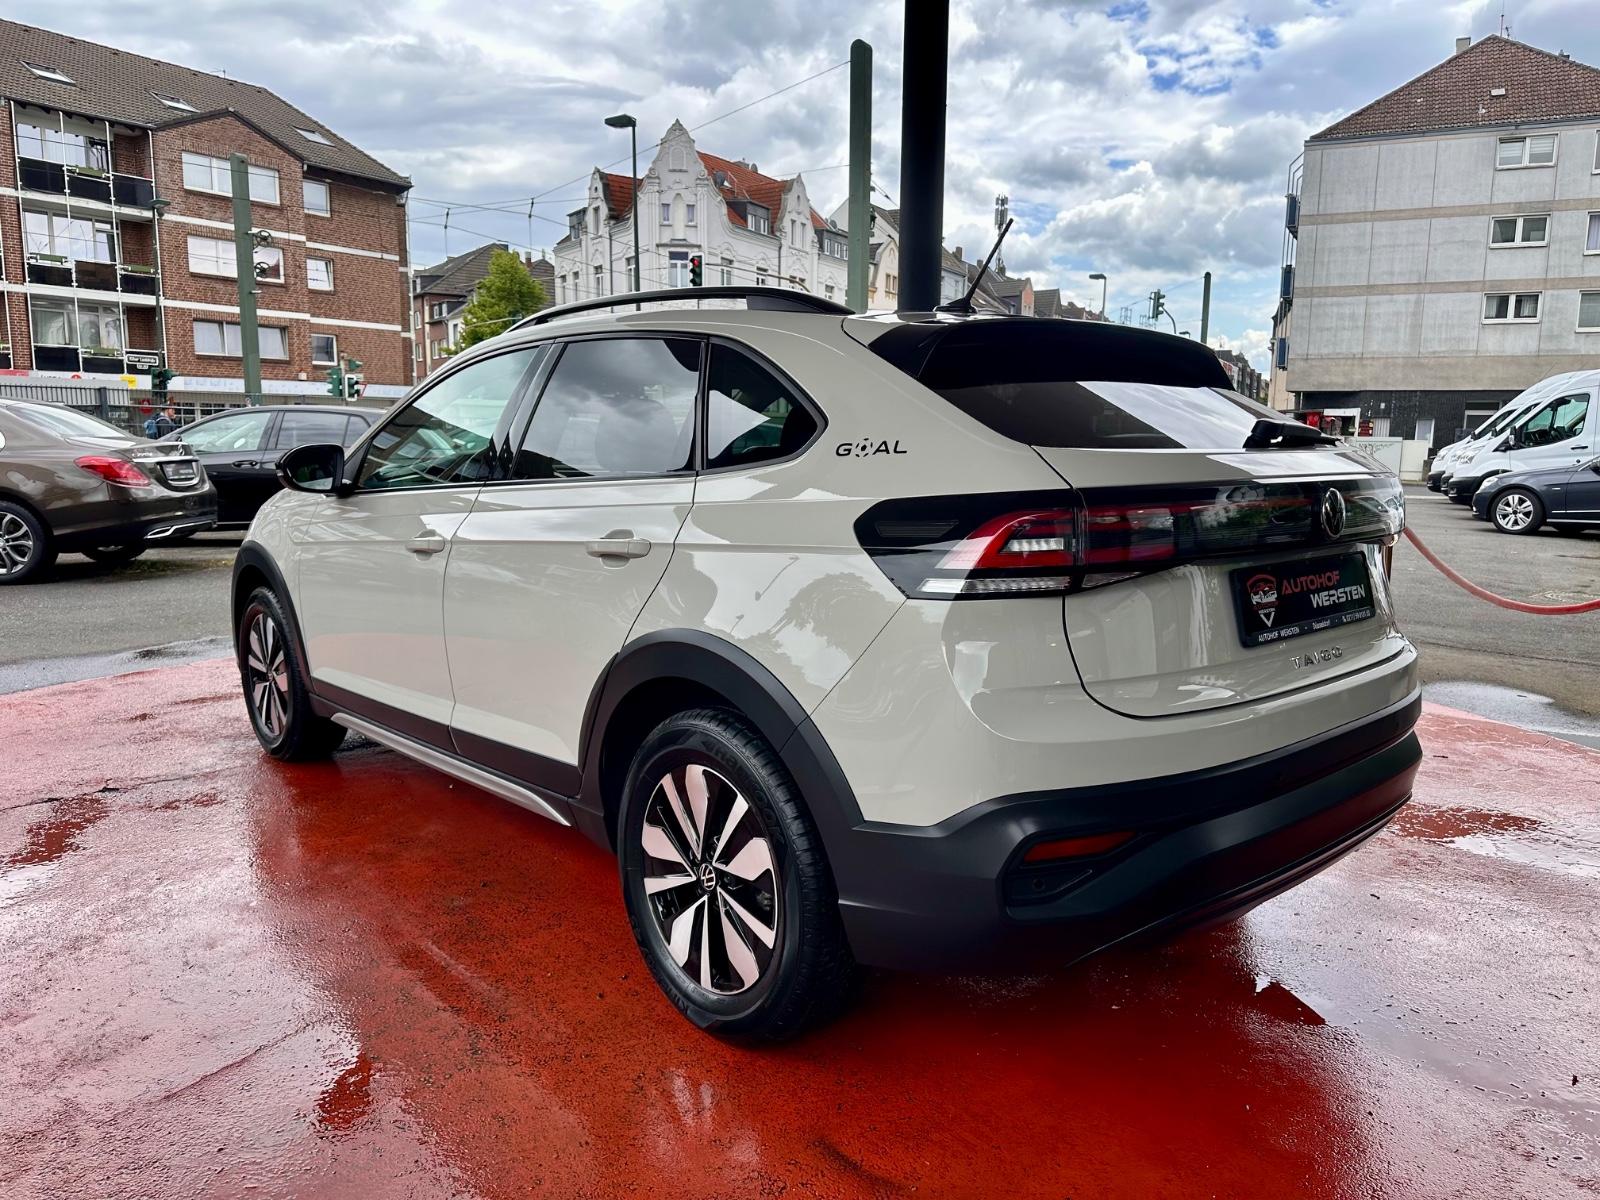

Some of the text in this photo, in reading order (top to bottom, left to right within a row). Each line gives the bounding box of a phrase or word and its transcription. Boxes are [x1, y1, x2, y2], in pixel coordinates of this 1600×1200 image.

[835, 437, 907, 457] GOAL
[1281, 570, 1341, 595] AUTOHOF
[1310, 584, 1366, 608] WERSTEN
[1258, 631, 1279, 642] AUTOHOF
[1280, 627, 1300, 637] WERSTEN
[1290, 646, 1343, 669] TAIGO
